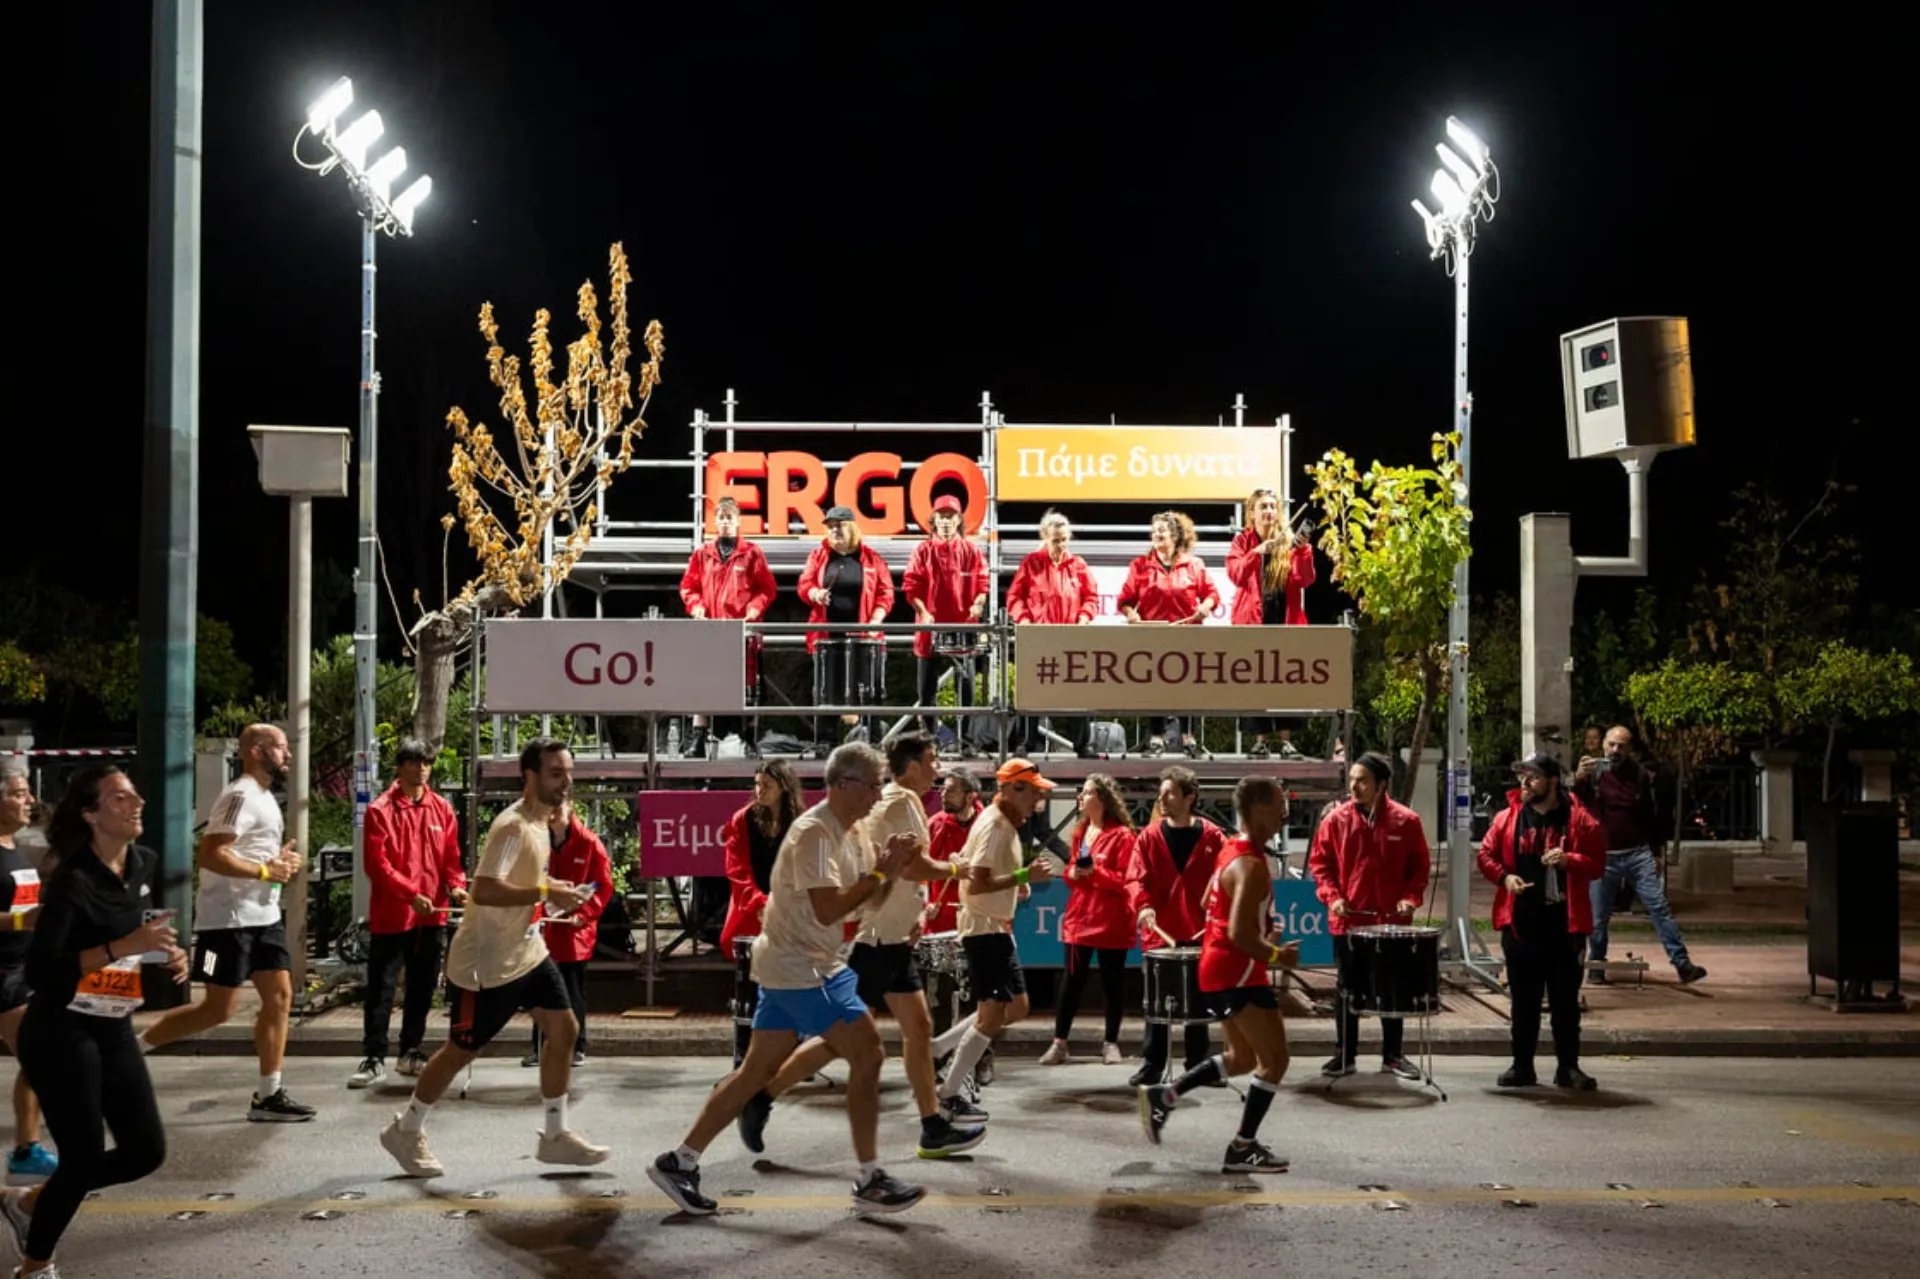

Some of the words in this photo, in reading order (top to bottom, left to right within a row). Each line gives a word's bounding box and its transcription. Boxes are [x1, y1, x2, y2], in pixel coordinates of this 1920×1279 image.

[1017, 444, 1117, 485] Πάμε
[705, 451, 988, 535] ERGO
[564, 640, 655, 687] Go!
[1036, 649, 1330, 684] #ERGOHellas
